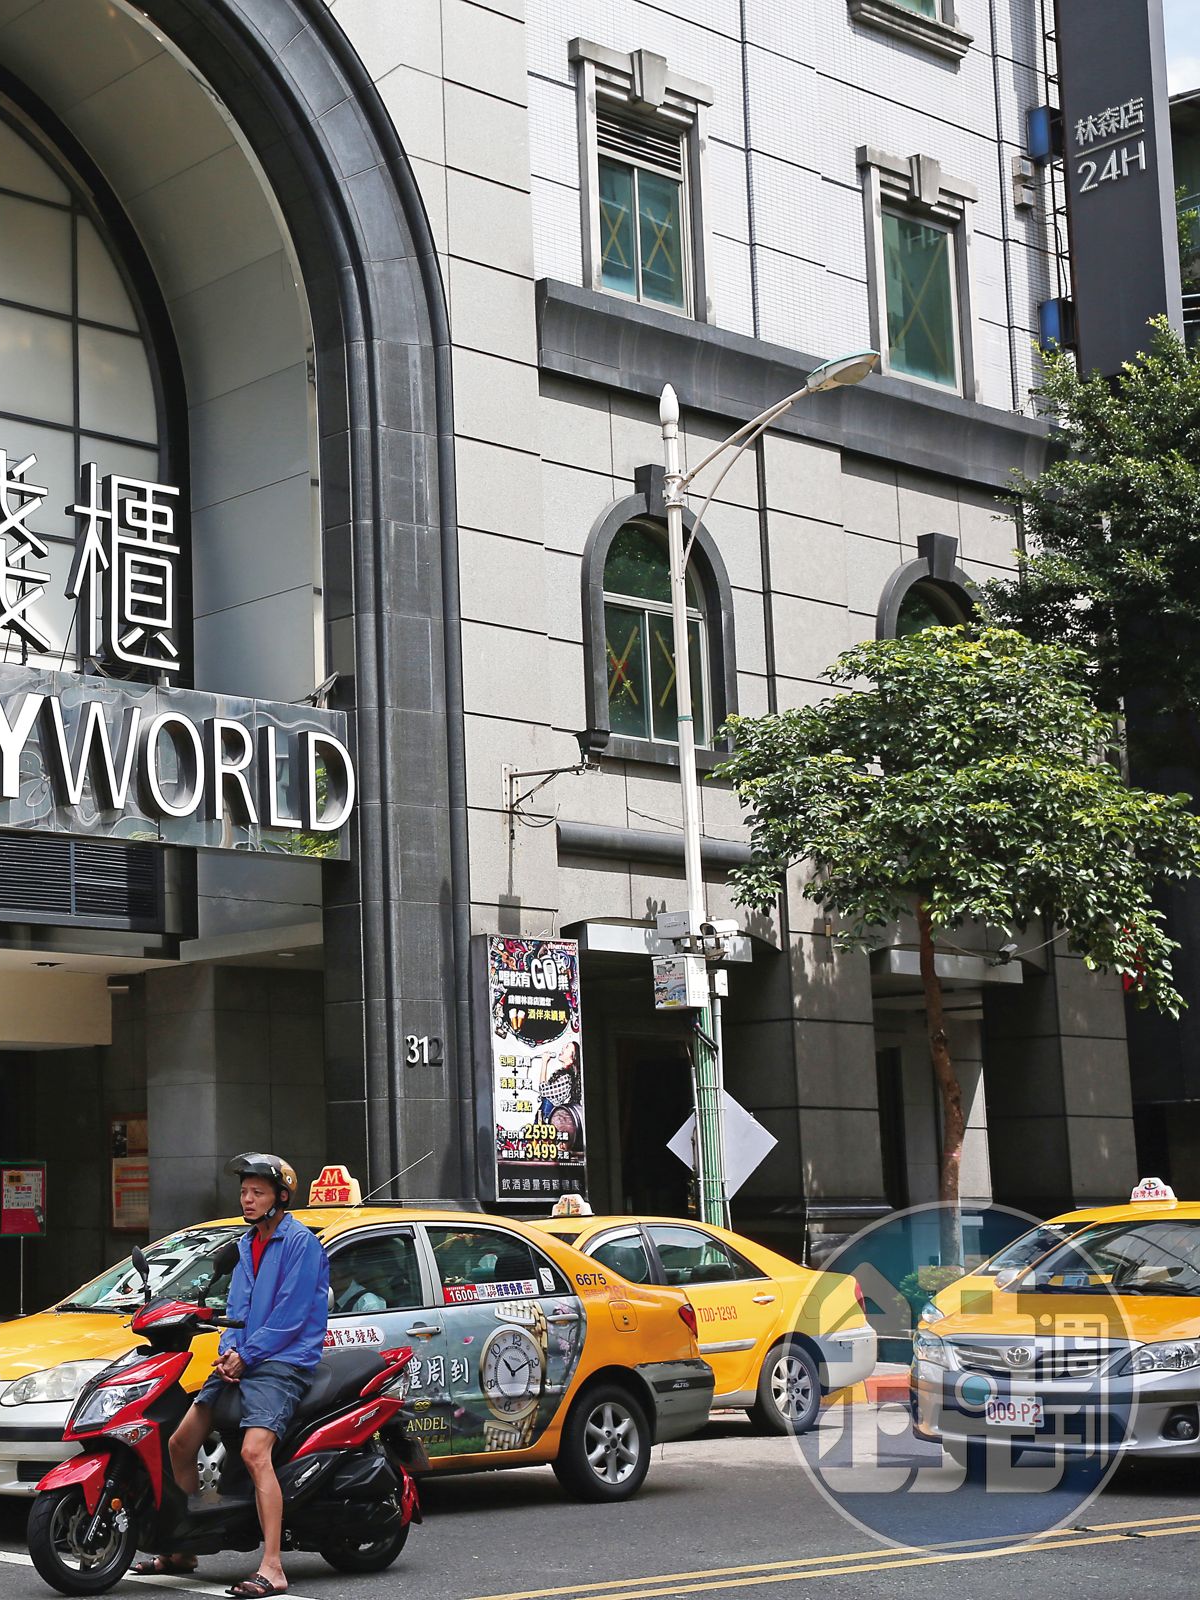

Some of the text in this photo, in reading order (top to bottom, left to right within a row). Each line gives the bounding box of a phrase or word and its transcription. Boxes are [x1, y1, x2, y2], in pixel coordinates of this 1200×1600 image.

[1074, 97, 1144, 145] 林森店
[1077, 140, 1146, 193] 24H
[406, 1034, 443, 1067] 312
[324, 1169, 340, 1185] M
[310, 1187, 351, 1203] 大都會
[576, 1273, 607, 1286] 6675
[697, 1305, 738, 1323] TDD-1293
[987, 1401, 1042, 1423] 009-P2
